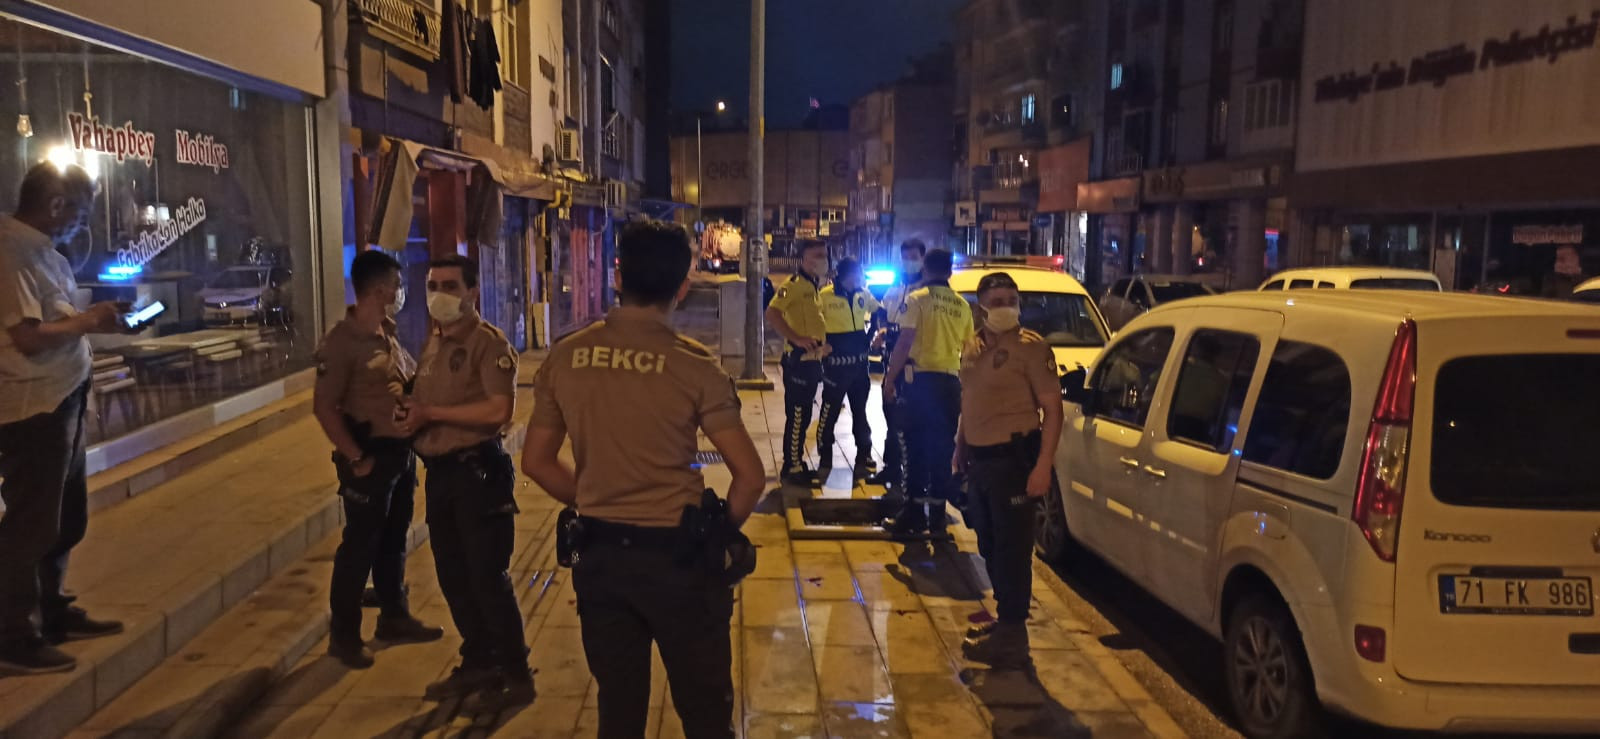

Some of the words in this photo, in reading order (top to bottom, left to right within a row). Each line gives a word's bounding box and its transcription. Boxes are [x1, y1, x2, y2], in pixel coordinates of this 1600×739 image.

[68, 112, 155, 167] Vahapbey
[175, 129, 229, 173] Mobilya
[1460, 580, 1484, 604] 71
[1505, 581, 1529, 605] FK
[1548, 582, 1588, 606] 986
